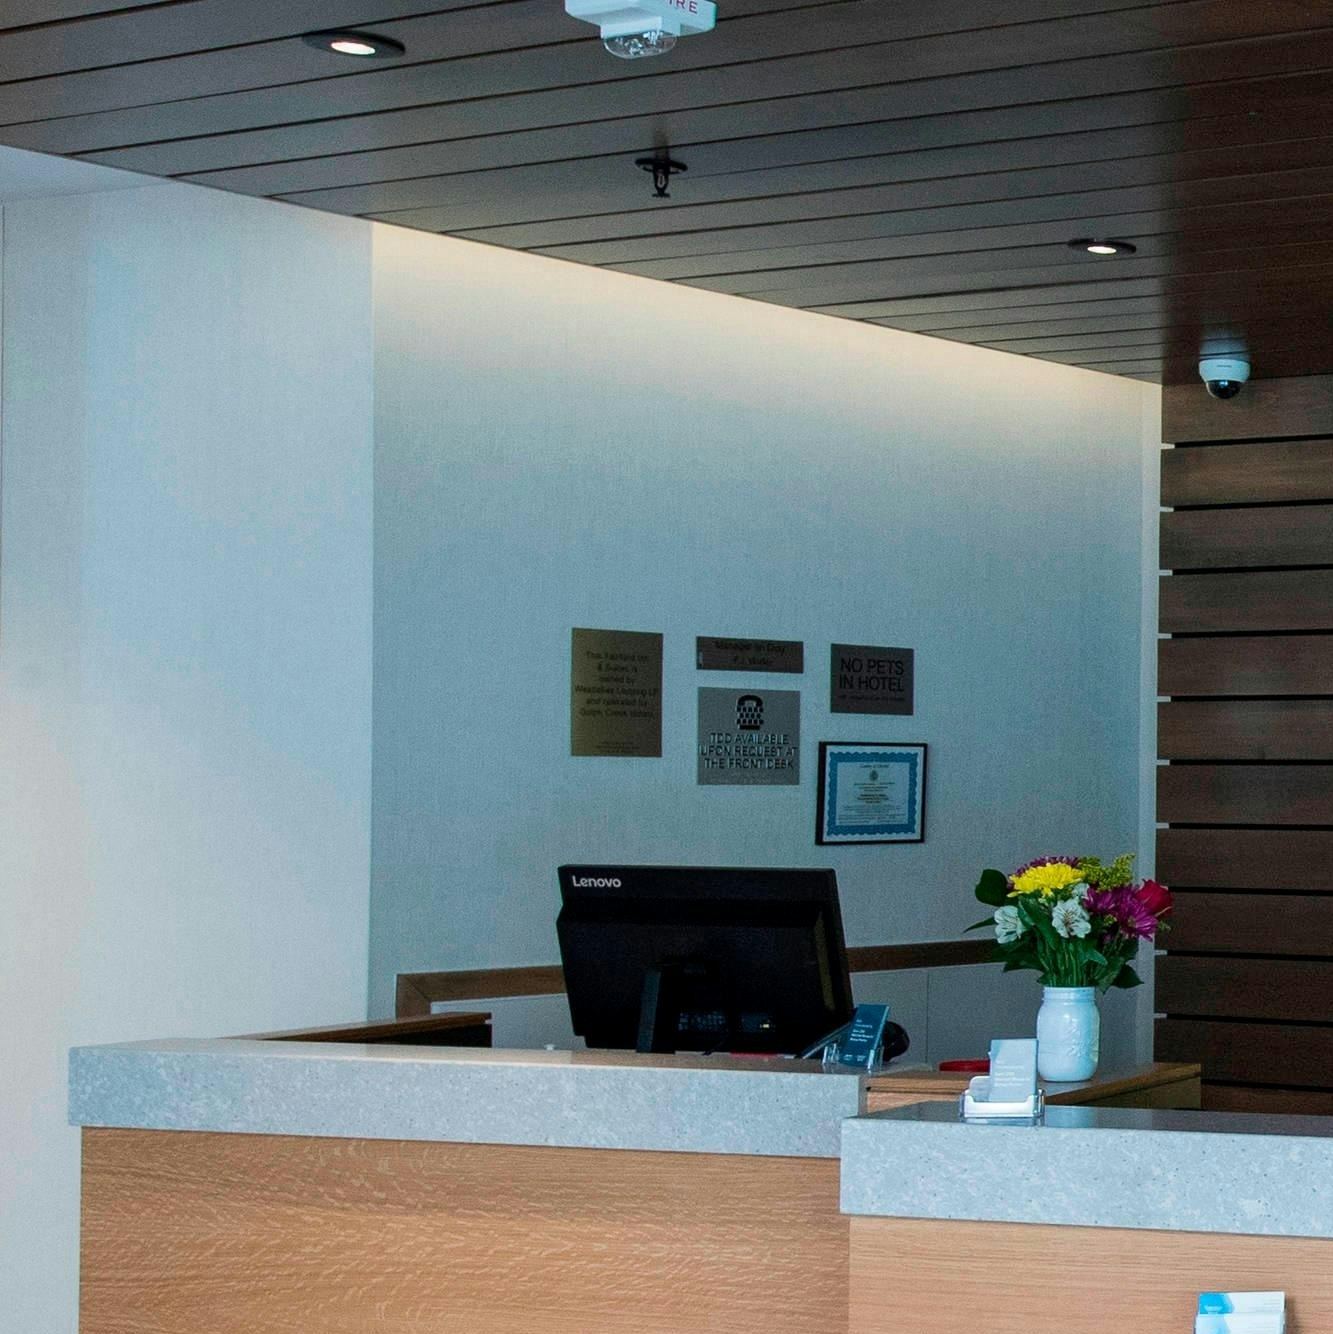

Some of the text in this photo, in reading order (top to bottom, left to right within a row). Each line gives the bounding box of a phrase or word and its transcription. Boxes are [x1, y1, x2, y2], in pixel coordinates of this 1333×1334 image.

[841, 657, 905, 676] NO PETS
[839, 674, 905, 692] IN HOTEL
[710, 732, 789, 745] TDD AVAILABLE
[701, 745, 799, 757] UPON REQUEST AT
[704, 757, 794, 770] THE FRONT DESK
[571, 875, 622, 888] Lenovo
